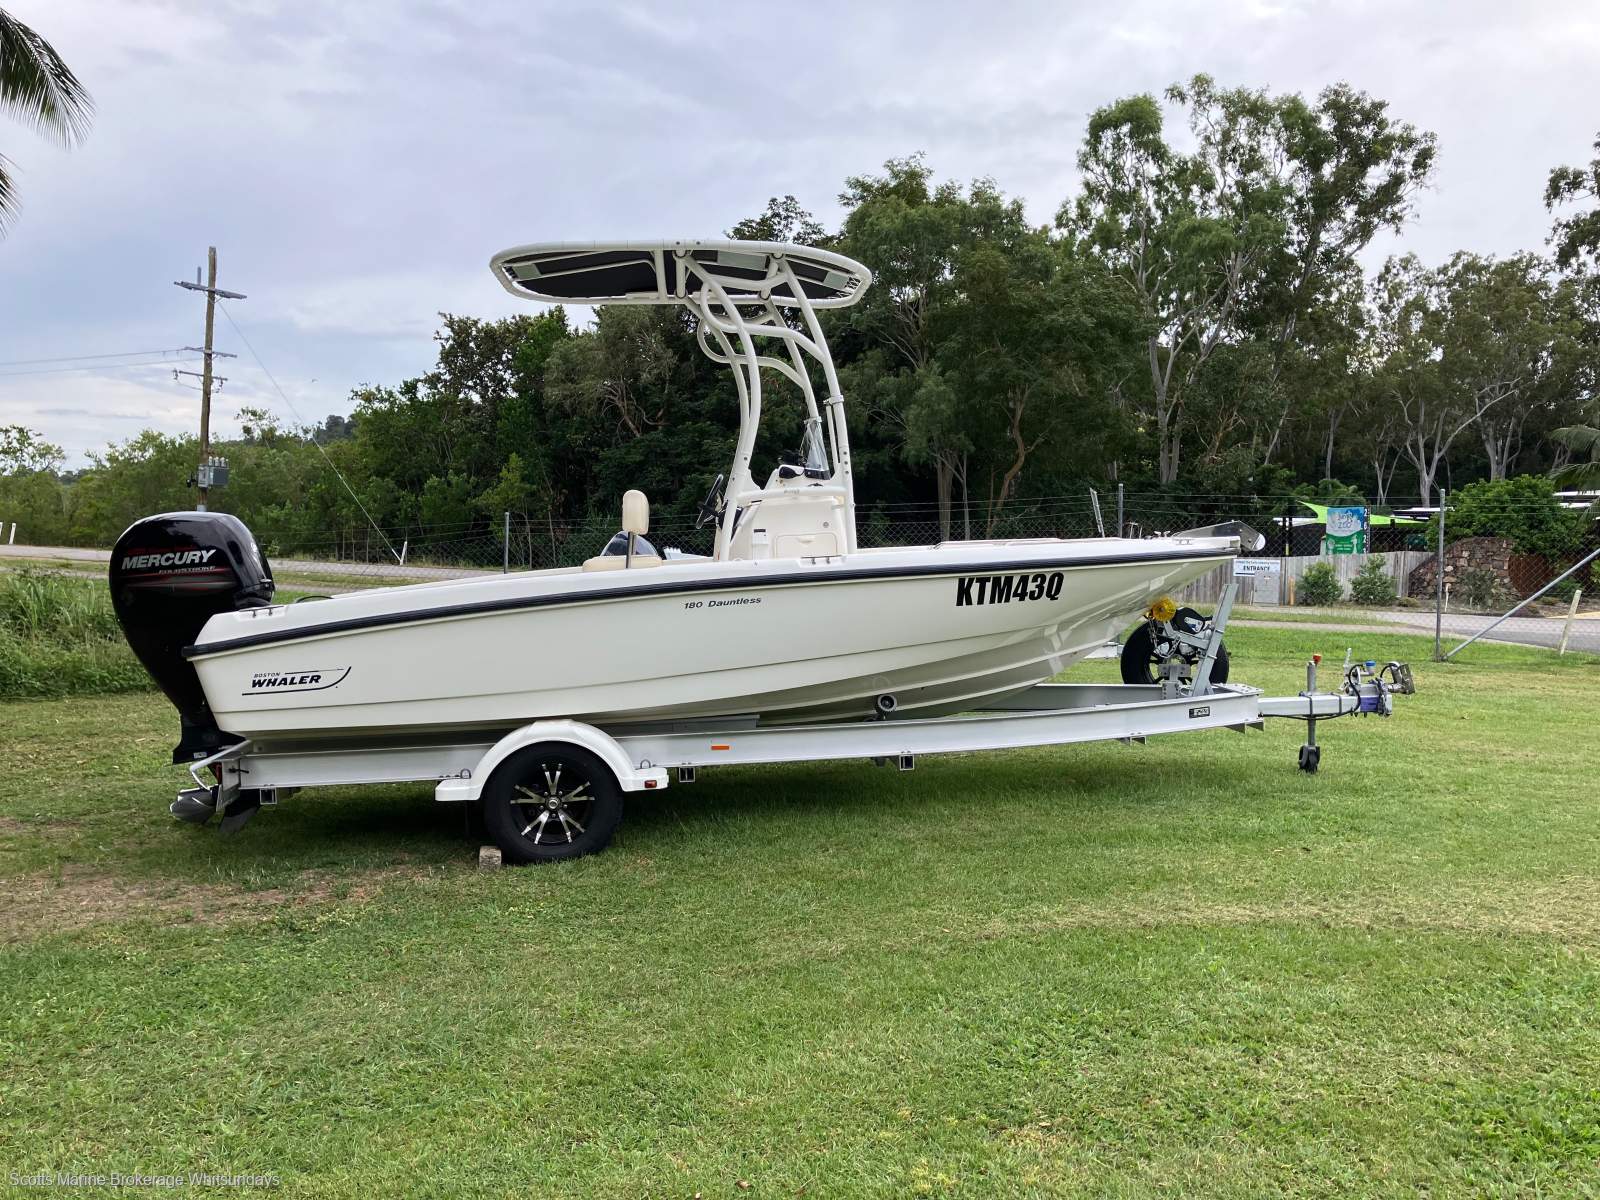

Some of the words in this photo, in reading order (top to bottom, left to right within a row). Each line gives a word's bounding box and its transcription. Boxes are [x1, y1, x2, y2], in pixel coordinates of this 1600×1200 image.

[121, 549, 217, 570] MERCURY
[956, 572, 1065, 607] KTM43Q
[684, 601, 704, 609] 180
[708, 597, 762, 608] Dauntless
[251, 674, 322, 688] WHALER
